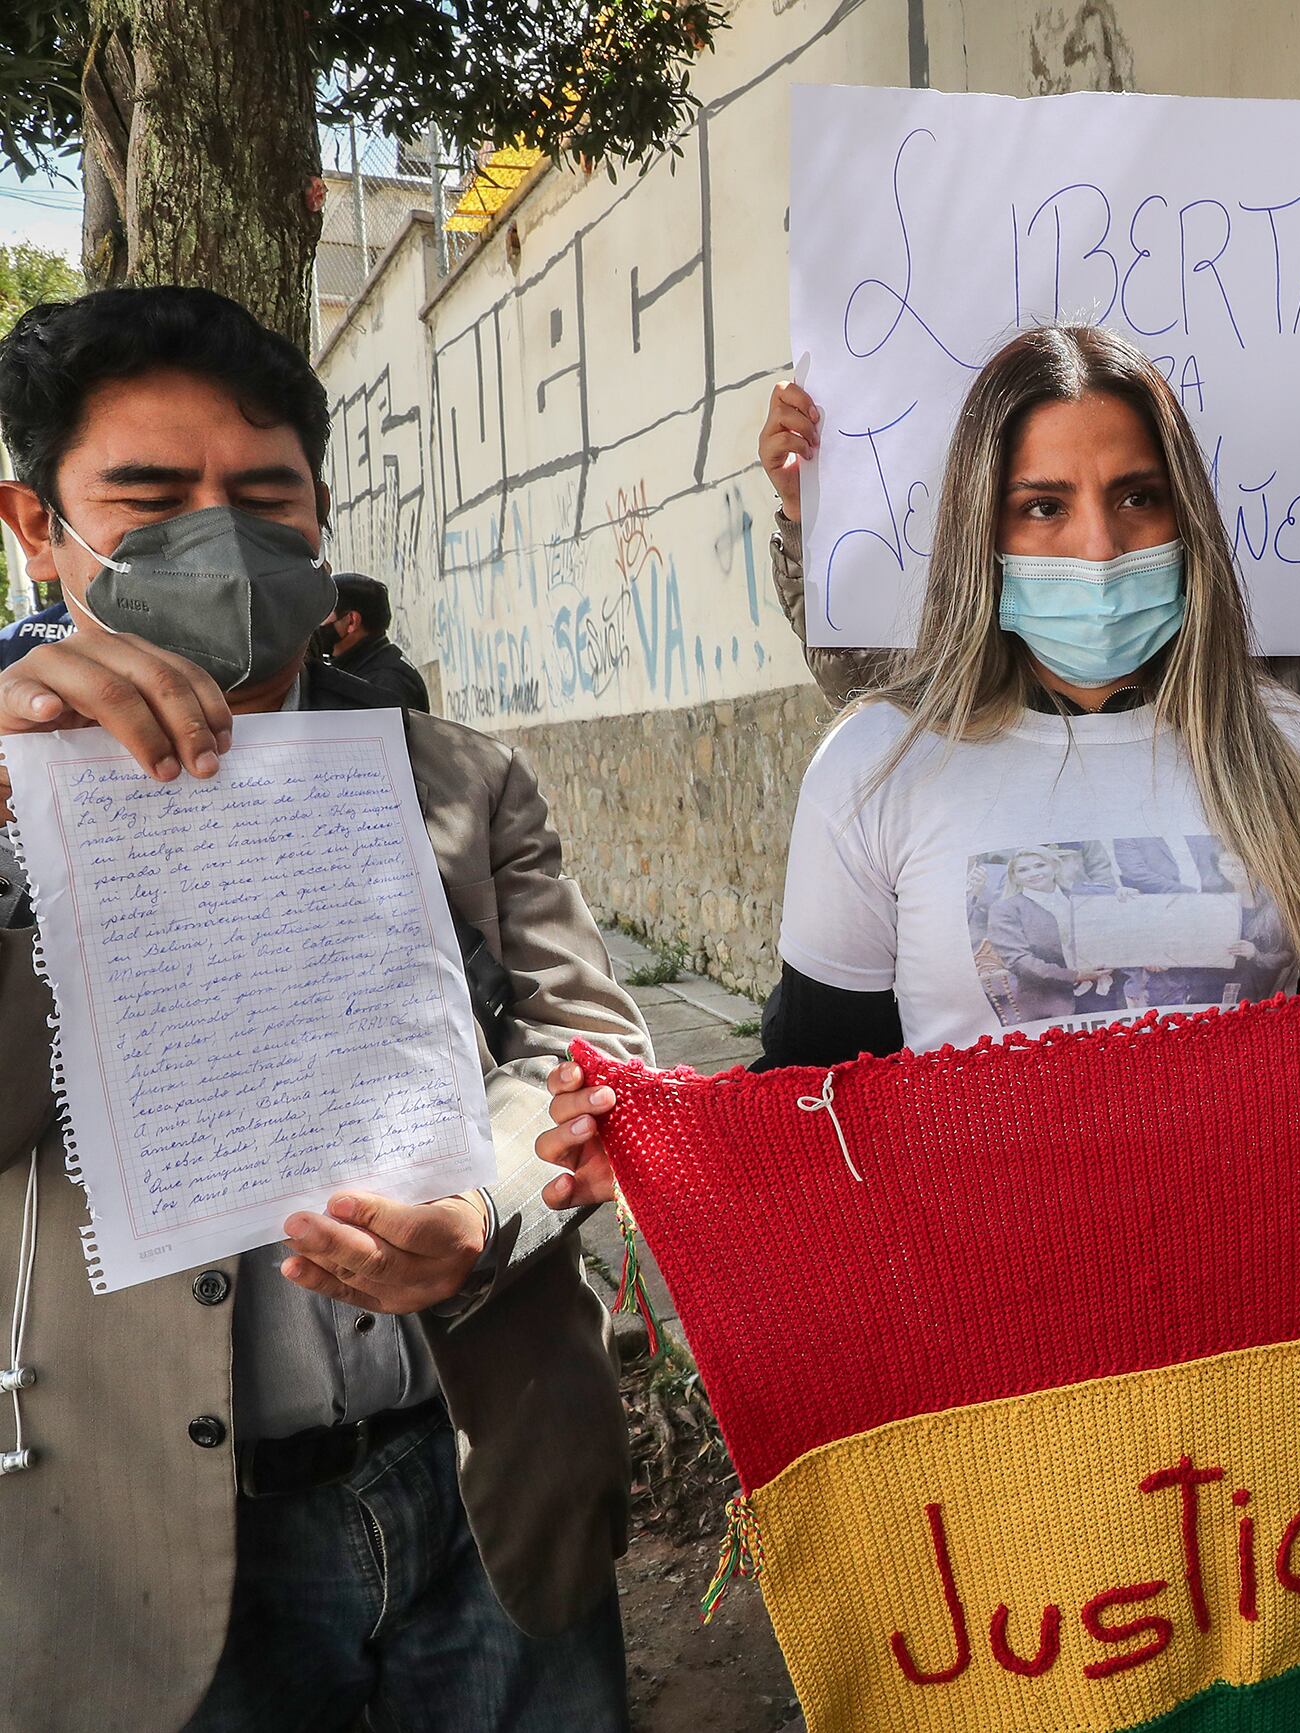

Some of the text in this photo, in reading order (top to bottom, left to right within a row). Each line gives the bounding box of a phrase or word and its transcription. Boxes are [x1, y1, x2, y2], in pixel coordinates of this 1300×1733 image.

[19, 622, 79, 639] PREN
[72, 787, 113, 812] Hoy
[124, 785, 183, 799] desde
[230, 776, 274, 789] celda
[76, 810, 96, 827] La
[106, 806, 146, 829] Paz,
[156, 795, 214, 818] tomo
[220, 799, 267, 811] una
[273, 794, 295, 804] de
[302, 785, 330, 801] las
[78, 827, 124, 848] más
[133, 823, 192, 838] duras
[197, 819, 224, 830] de
[231, 819, 261, 829] mi
[330, 803, 356, 819] Hoy
[90, 856, 118, 865] en
[127, 842, 184, 860] huelga
[192, 840, 216, 851] de
[311, 822, 350, 838] Estoy
[92, 865, 161, 889] perada
[168, 862, 192, 874] de
[200, 859, 232, 871] ver
[236, 856, 268, 866] un
[350, 836, 405, 856] justicia
[98, 890, 120, 905] ni
[179, 879, 210, 892] Veo
[218, 877, 255, 891] que
[291, 857, 351, 876] acción
[99, 903, 161, 928] podrá
[197, 893, 265, 914] ayudar
[270, 890, 286, 900] a
[296, 882, 337, 900] que
[336, 876, 359, 890] la
[101, 890, 415, 944] dad internacional entienda que
[107, 955, 131, 964] en
[222, 927, 245, 945] la
[249, 923, 329, 946] justicia
[362, 912, 383, 922] de
[107, 960, 181, 982] Morales
[185, 962, 193, 976] y
[256, 943, 293, 957] Arce
[385, 920, 421, 936] Estoy
[114, 1005, 146, 1024] las
[232, 986, 278, 1004] para
[279, 970, 354, 994] mostrar
[356, 964, 376, 977] al
[199, 971, 242, 991] pero
[115, 1032, 126, 1049] y
[134, 1021, 158, 1038] al
[158, 1010, 240, 1036] mundo
[246, 1005, 280, 1023] que
[120, 1042, 153, 1061] del
[228, 1027, 259, 1041] no
[338, 998, 395, 1017] borrar
[401, 993, 419, 1007] de
[424, 989, 442, 1001] la
[123, 1054, 199, 1083] historia
[207, 1049, 242, 1070] que
[196, 1054, 303, 1085] encontrados
[306, 1052, 318, 1069] y
[234, 1076, 267, 1096] del
[132, 1122, 147, 1138] A
[154, 1119, 191, 1136] mis
[255, 1090, 311, 1108] Bolivia
[318, 1087, 341, 1097] es
[317, 1095, 377, 1116] luchen
[383, 1088, 410, 1105] por
[414, 1077, 453, 1093] ella
[142, 1168, 152, 1183] y
[160, 1151, 204, 1171] sobre
[266, 1121, 325, 1146] luchen
[333, 1117, 366, 1136] por
[366, 1106, 385, 1122] la
[147, 1177, 182, 1194] Que
[348, 1135, 374, 1146] se
[151, 1199, 178, 1215] Los
[187, 1186, 229, 1207] amo
[237, 1178, 273, 1192] con
[278, 1158, 323, 1179] todas
